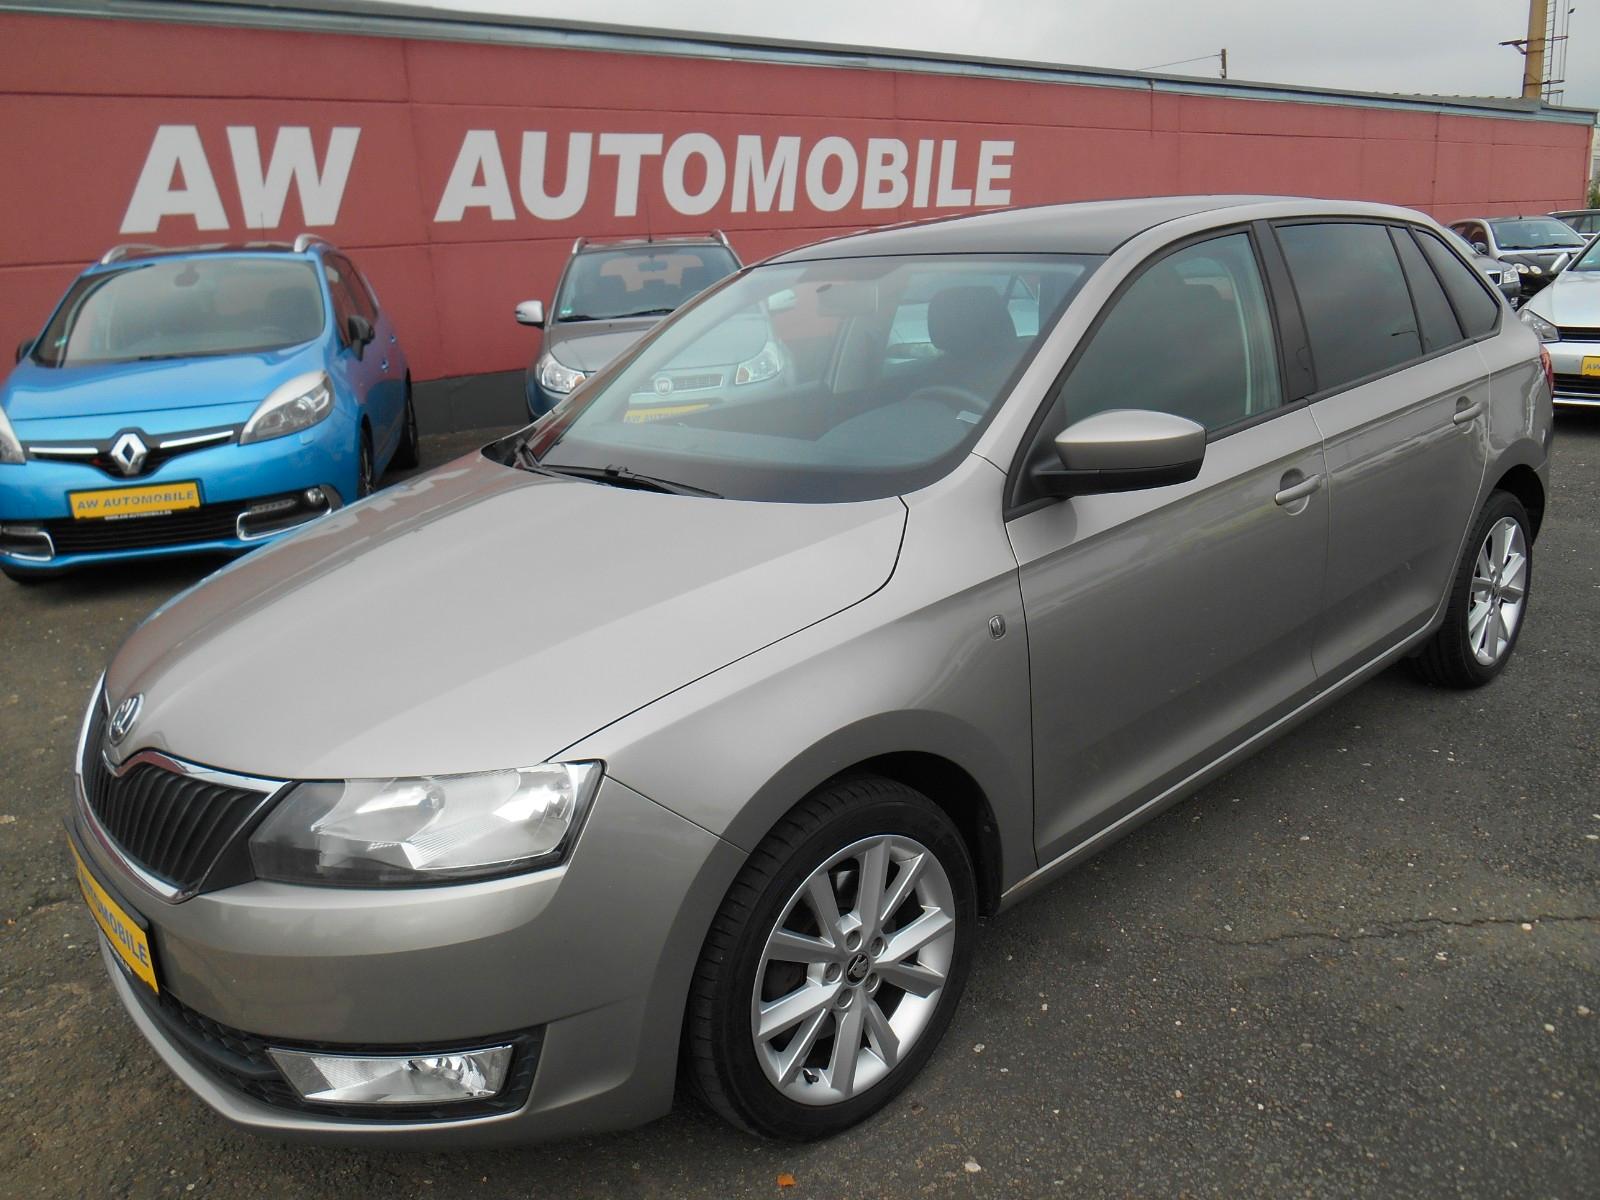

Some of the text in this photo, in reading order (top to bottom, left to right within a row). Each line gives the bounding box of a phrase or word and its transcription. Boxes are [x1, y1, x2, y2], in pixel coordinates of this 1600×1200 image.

[120, 125, 1016, 233] AW AUTOMOBILE
[77, 490, 195, 511] AW AUTOMOBILE
